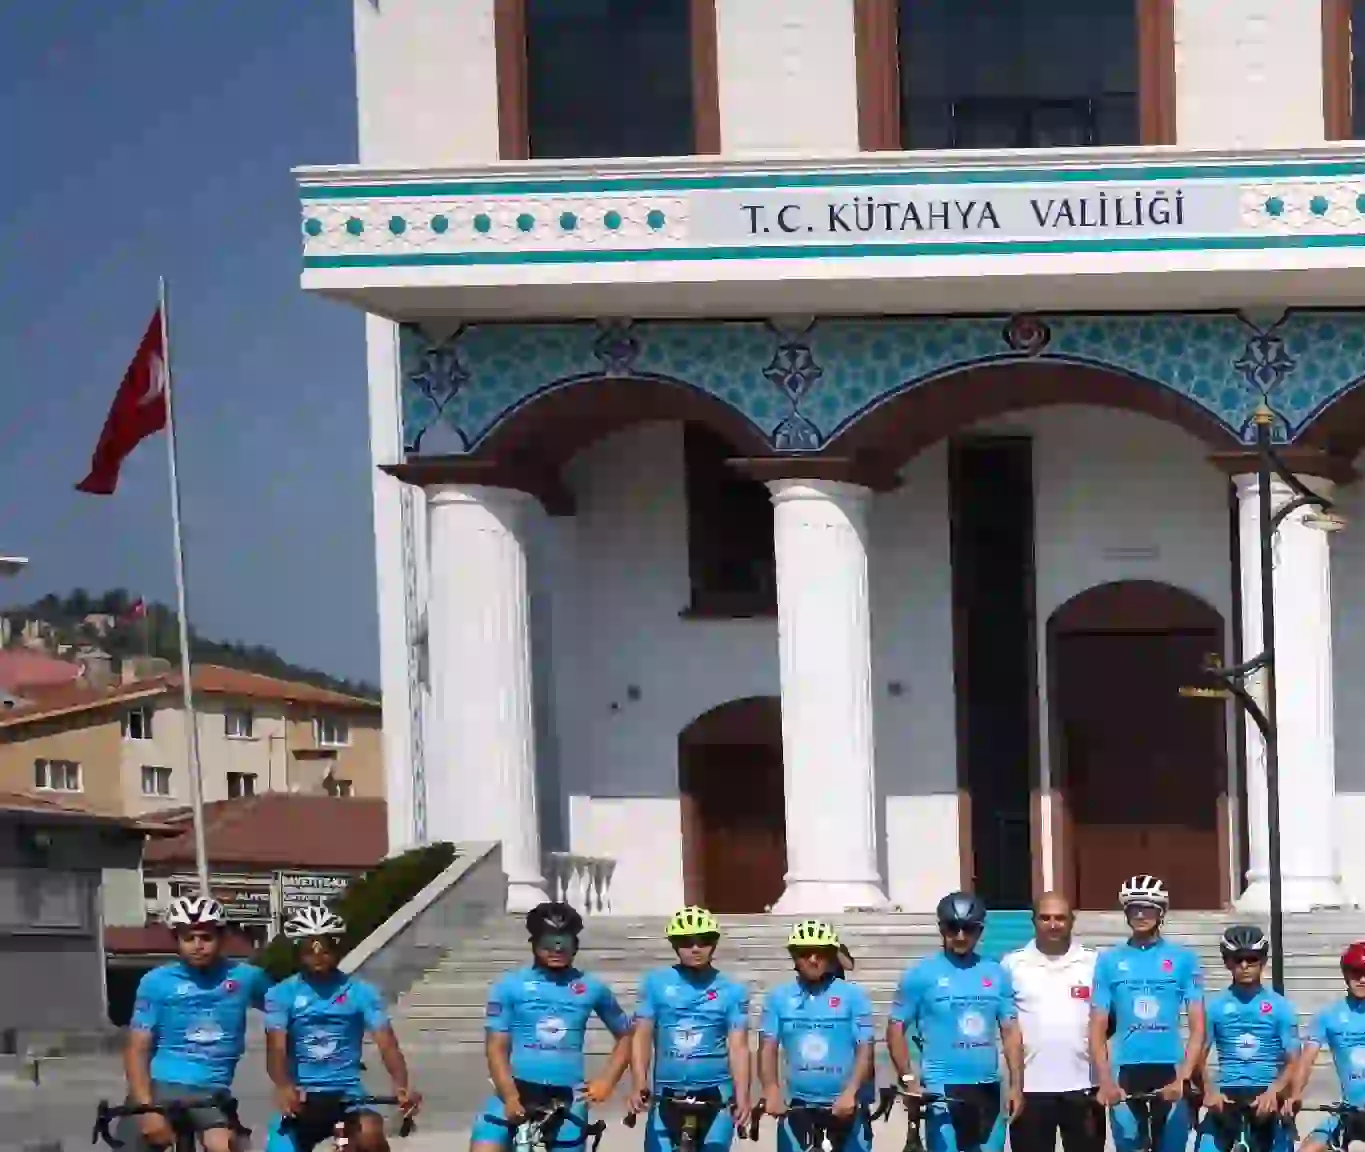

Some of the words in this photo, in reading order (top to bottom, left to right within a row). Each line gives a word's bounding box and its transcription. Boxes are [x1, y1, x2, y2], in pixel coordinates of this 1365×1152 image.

[740, 203, 813, 234] T.C.
[827, 195, 1001, 232] KÜTAHYA
[1030, 188, 1186, 228] VALİLİĞİ
